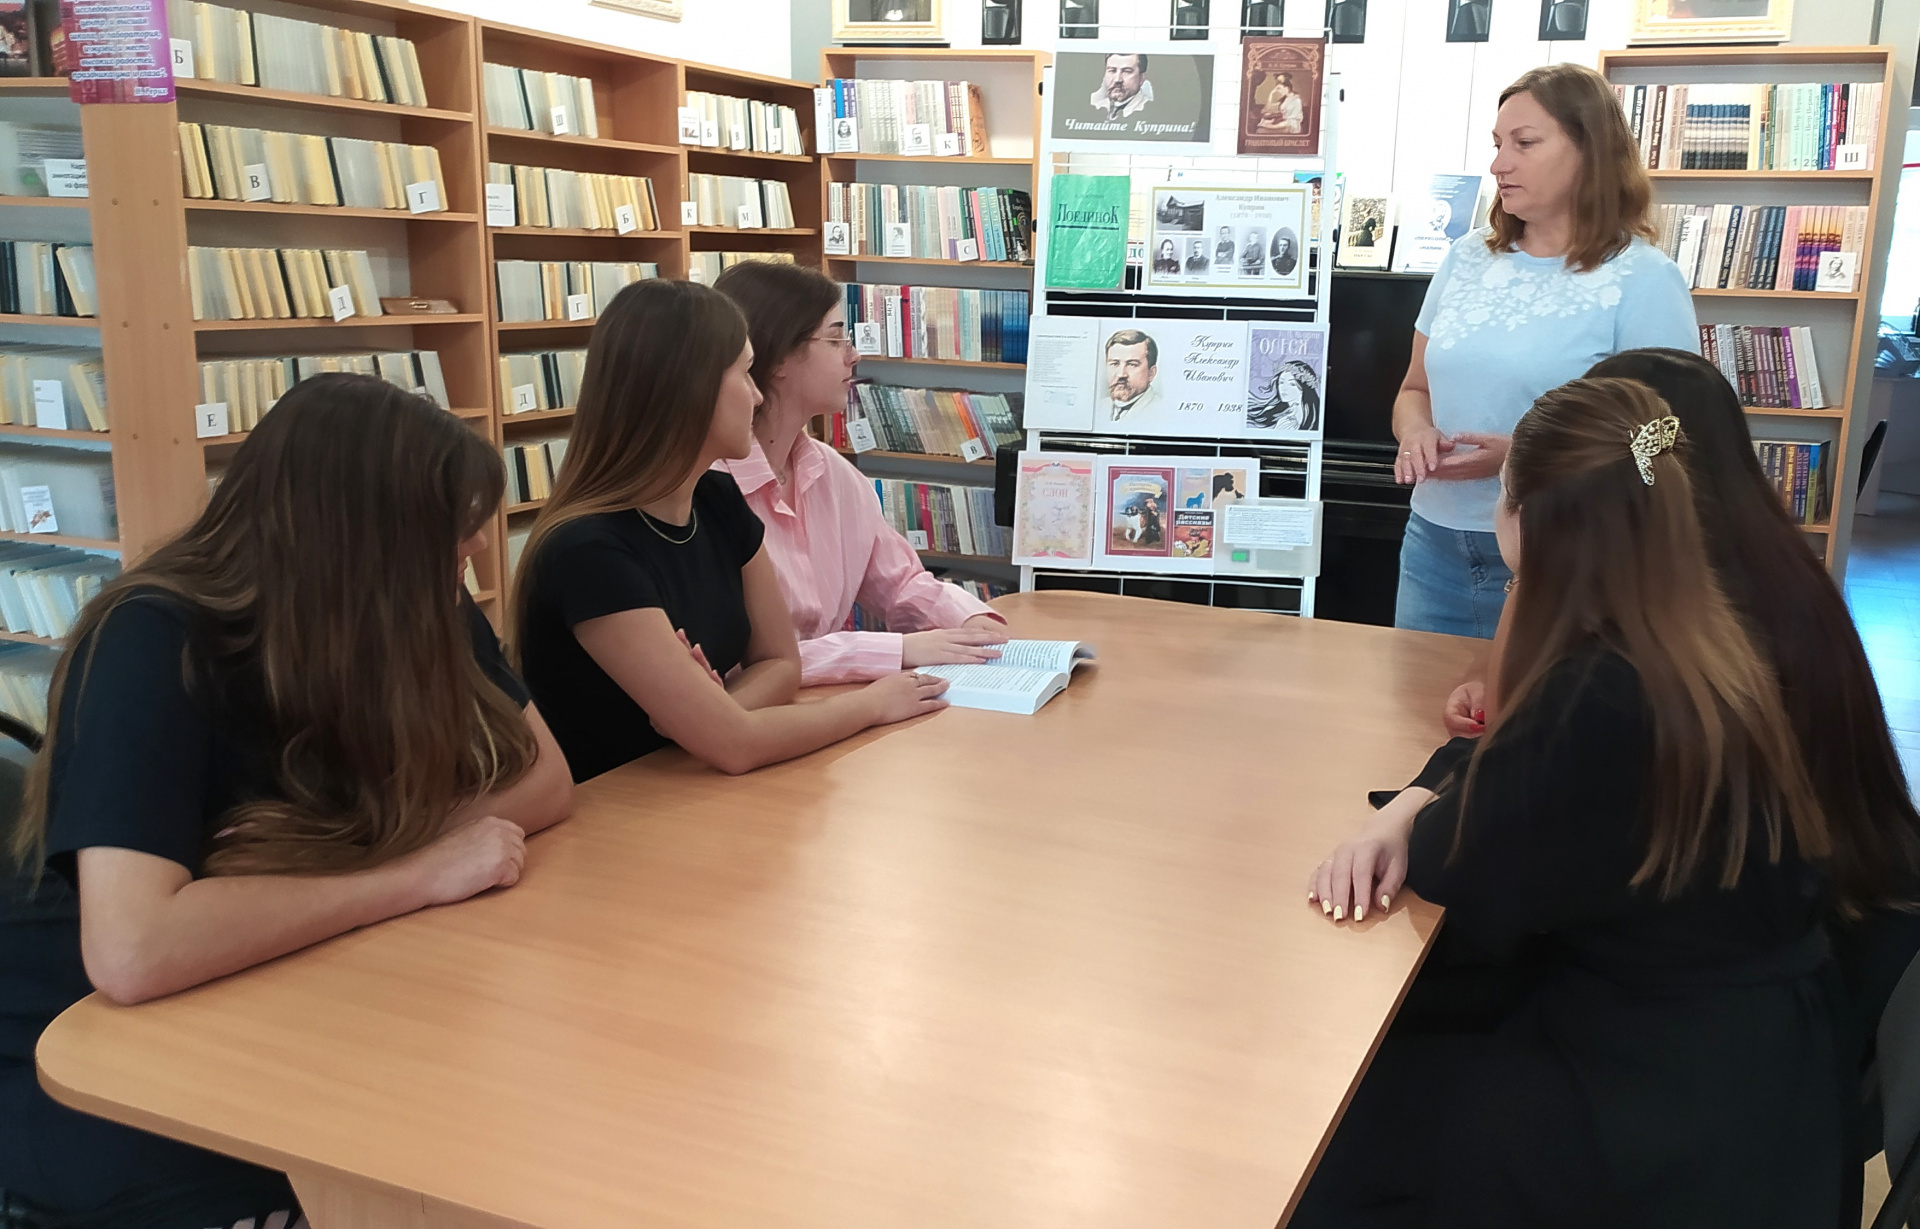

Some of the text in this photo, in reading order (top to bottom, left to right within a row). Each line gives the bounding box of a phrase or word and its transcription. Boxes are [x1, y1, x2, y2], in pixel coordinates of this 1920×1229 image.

[174, 49, 184, 64] Б
[1065, 118, 1196, 135] Читайте Куприна!
[1792, 157, 1798, 167] 1
[1803, 158, 1810, 167] 2
[1844, 152, 1859, 163] Ш
[250, 175, 261, 189] В
[417, 191, 428, 204] Г
[1216, 194, 1253, 203] Александр
[687, 208, 692, 219] К
[1238, 204, 1265, 212] Куприн
[622, 212, 630, 225] Б
[742, 212, 749, 221] М
[963, 245, 970, 255] С
[576, 302, 582, 313] Г
[1190, 335, 1234, 352] Куприн
[1259, 337, 1308, 356] ОЛЕСЯ
[1184, 352, 1240, 369] Александр
[1183, 369, 1235, 382] Иванович
[520, 393, 528, 407] Д
[1178, 402, 1243, 413] 1870 1938
[206, 413, 217, 428] Е
[970, 445, 978, 455] В
[1785, 464, 1794, 492] История
[1042, 488, 1068, 498] СЛОН
[1175, 519, 1212, 527] рассказы
[914, 536, 922, 545] Д
